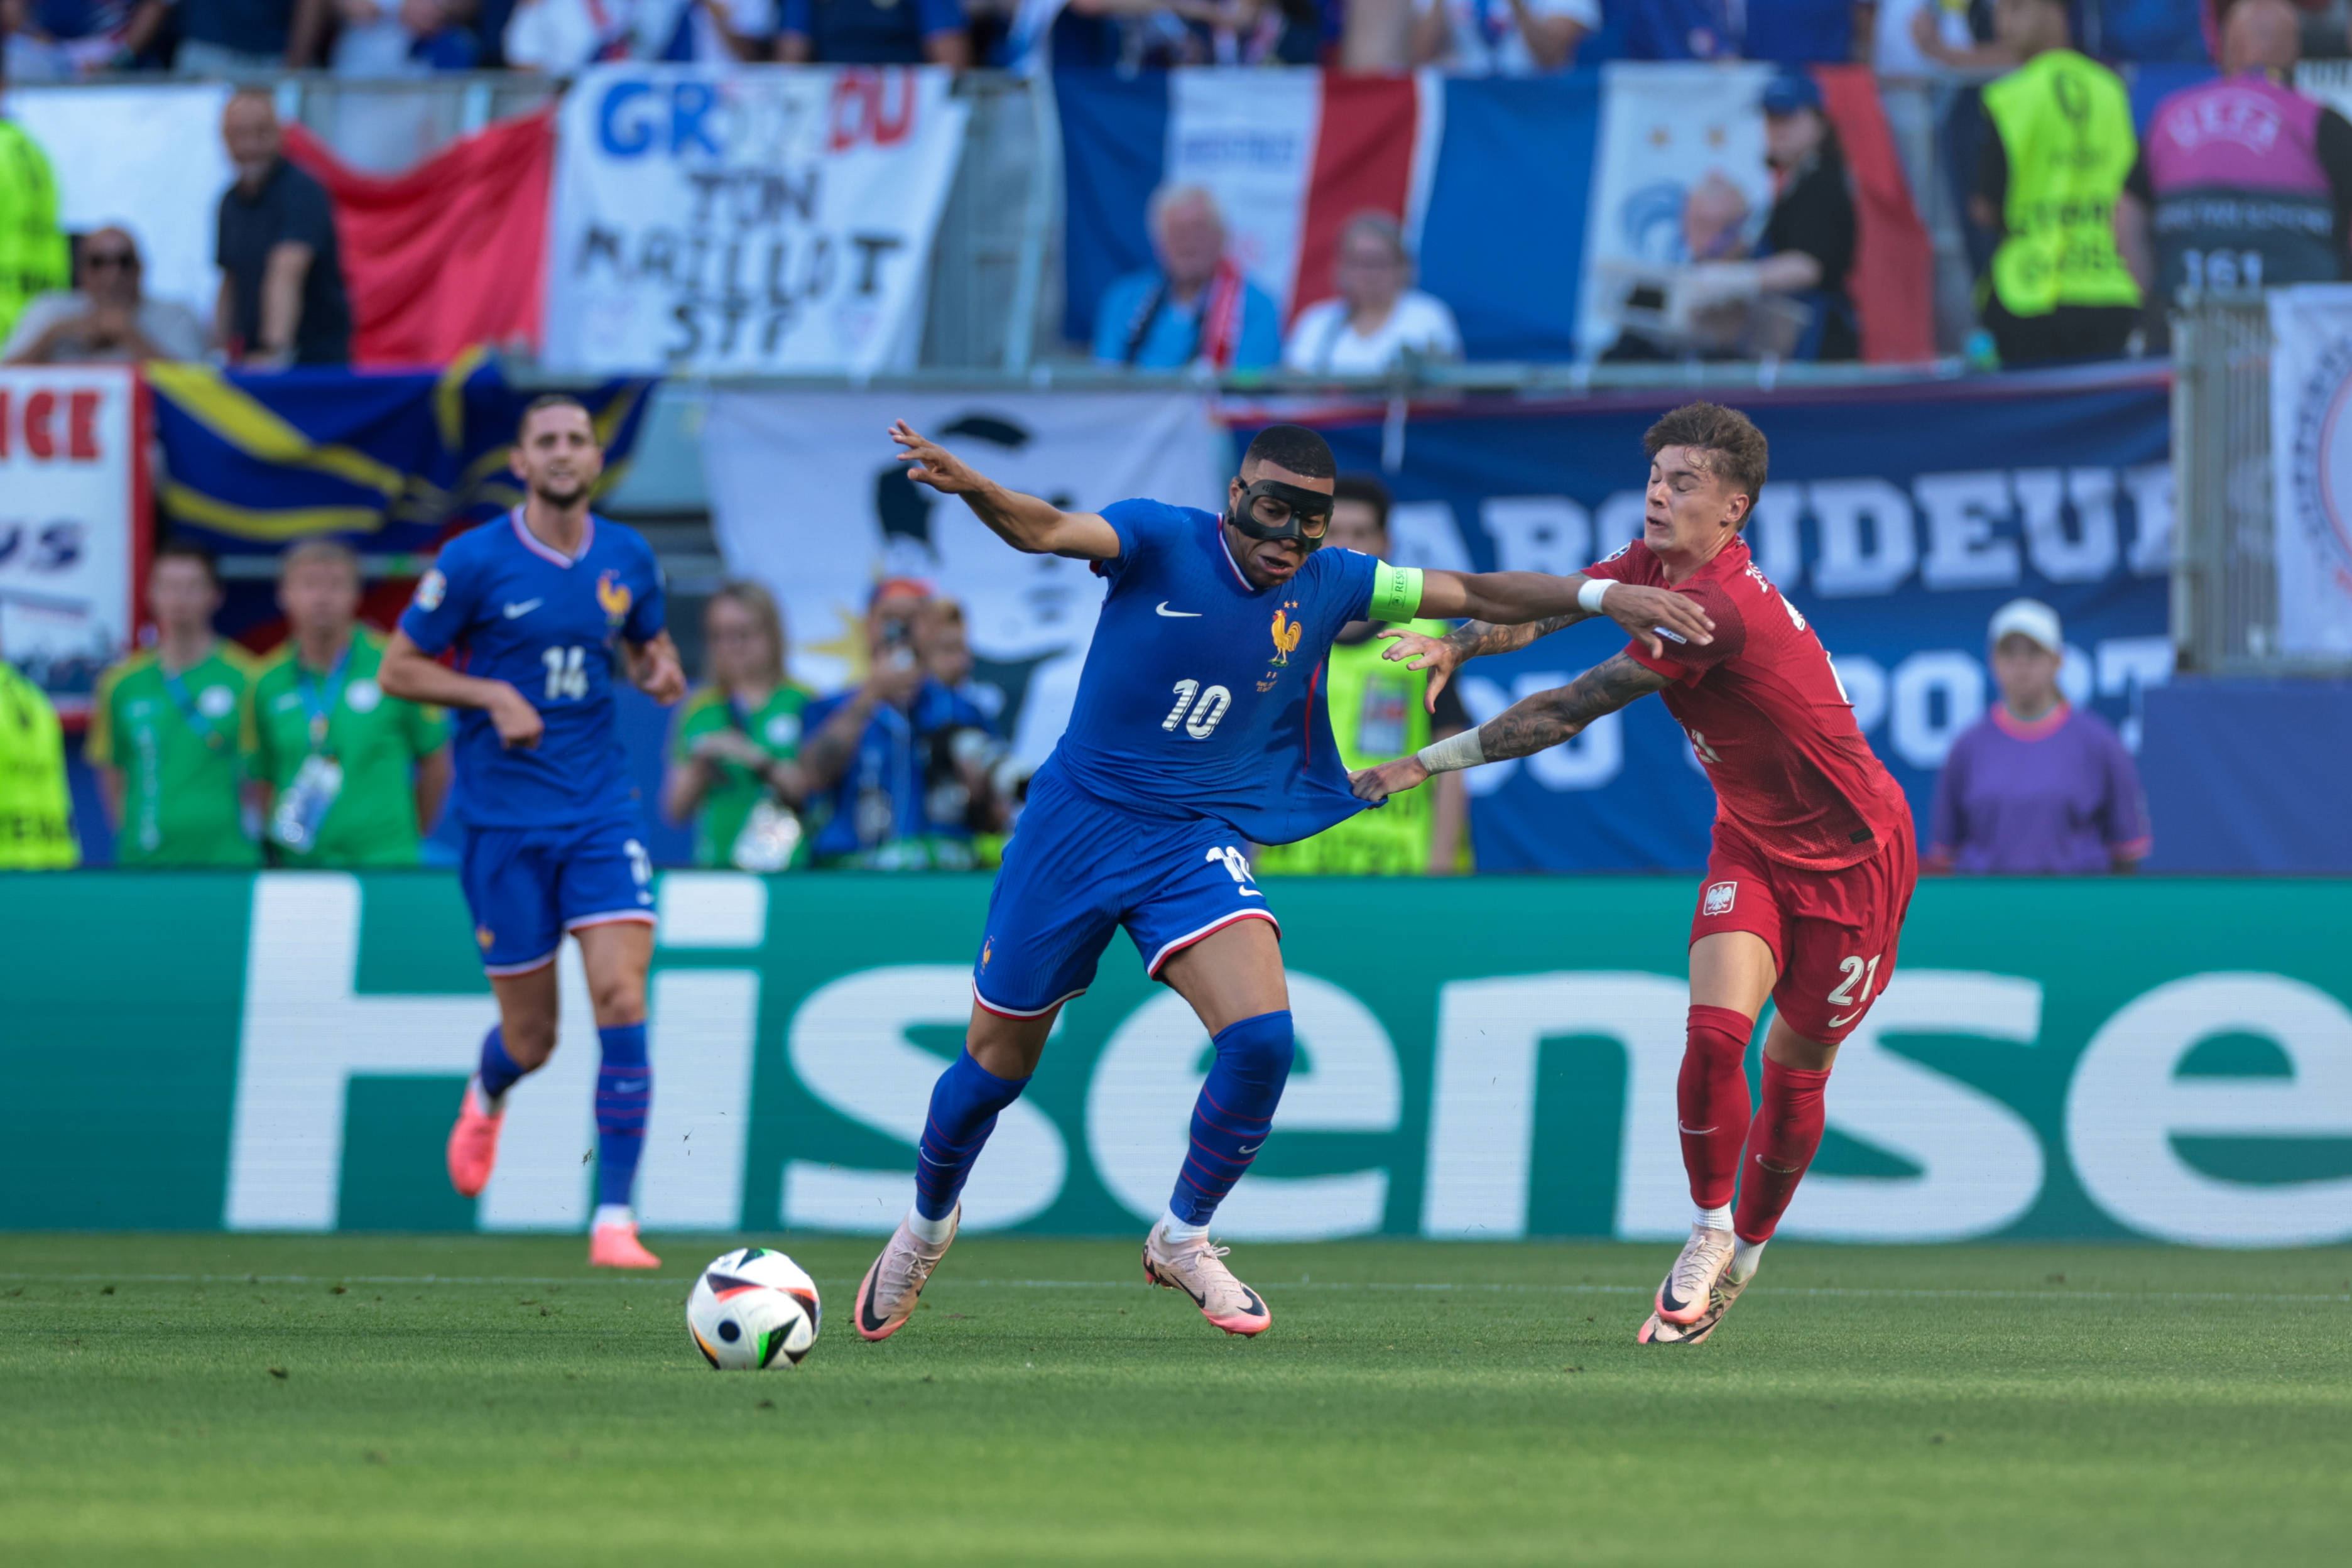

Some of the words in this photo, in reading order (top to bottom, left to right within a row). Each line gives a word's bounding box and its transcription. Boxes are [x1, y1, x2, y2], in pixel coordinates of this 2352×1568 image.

[597, 65, 916, 161] GROU
[0, 388, 103, 462] CE
[542, 645, 589, 701] 14
[1162, 678, 1231, 739] 10
[1827, 954, 1881, 1006] 21
[221, 871, 2352, 1249] Hisense
